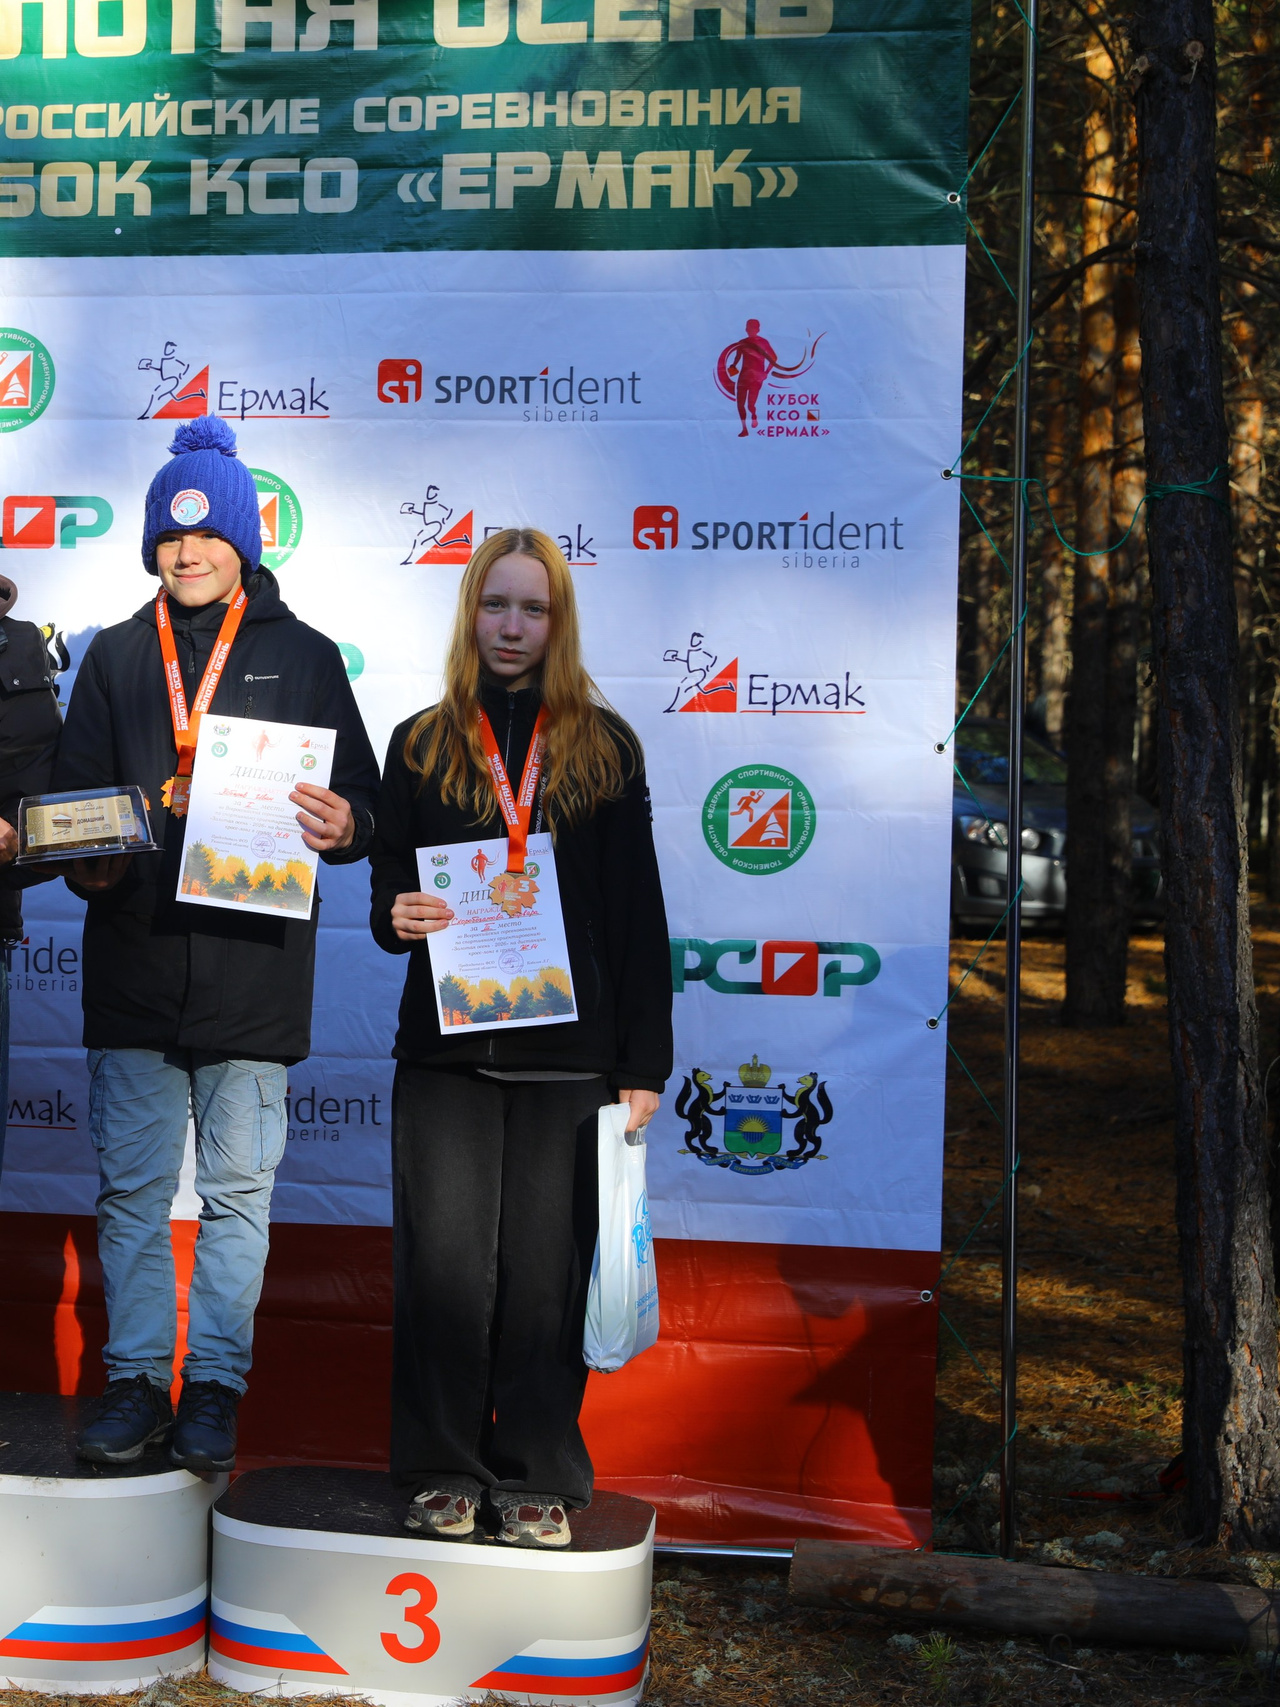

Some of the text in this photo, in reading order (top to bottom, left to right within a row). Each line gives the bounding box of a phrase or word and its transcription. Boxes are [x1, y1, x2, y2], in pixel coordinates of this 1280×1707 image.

[352, 86, 802, 133] СОРЕВНОВАНИЯ
[189, 157, 358, 217] КСО
[396, 148, 799, 210] «ЕРМАК»
[218, 377, 331, 421] Ермак
[434, 365, 642, 405] SPORTident
[767, 393, 819, 406] КУБОК
[523, 405, 599, 423] siberia
[757, 425, 830, 438] «ЕРМАК»
[767, 409, 800, 421] КСО
[691, 511, 905, 551] SPORTident
[781, 551, 861, 569] siberia
[170, 659, 189, 731] ЗОЛОТАЯ ОСЕНЬ
[198, 642, 231, 713] ЗОЛОТАЯ ОСЕНЬ
[748, 671, 866, 716] Ермак
[230, 765, 297, 784] ДИПЛОМ
[492, 752, 520, 826] ЗОЛОТАЯ ОСЕНЬ
[523, 766, 539, 808] ЗОЛОТАЯ
[737, 769, 794, 787] СПОРТИВНОГО
[707, 778, 734, 820] ФЕДЕРАЦИЯ
[707, 824, 729, 857] ОБЛАСТИ
[787, 791, 811, 859] ОРИЕНТИРОВАНИЯ
[459, 889, 492, 905] ДИП
[519, 880, 530, 893] 3
[497, 920, 522, 930] место
[379, 1572, 441, 1664] 3
